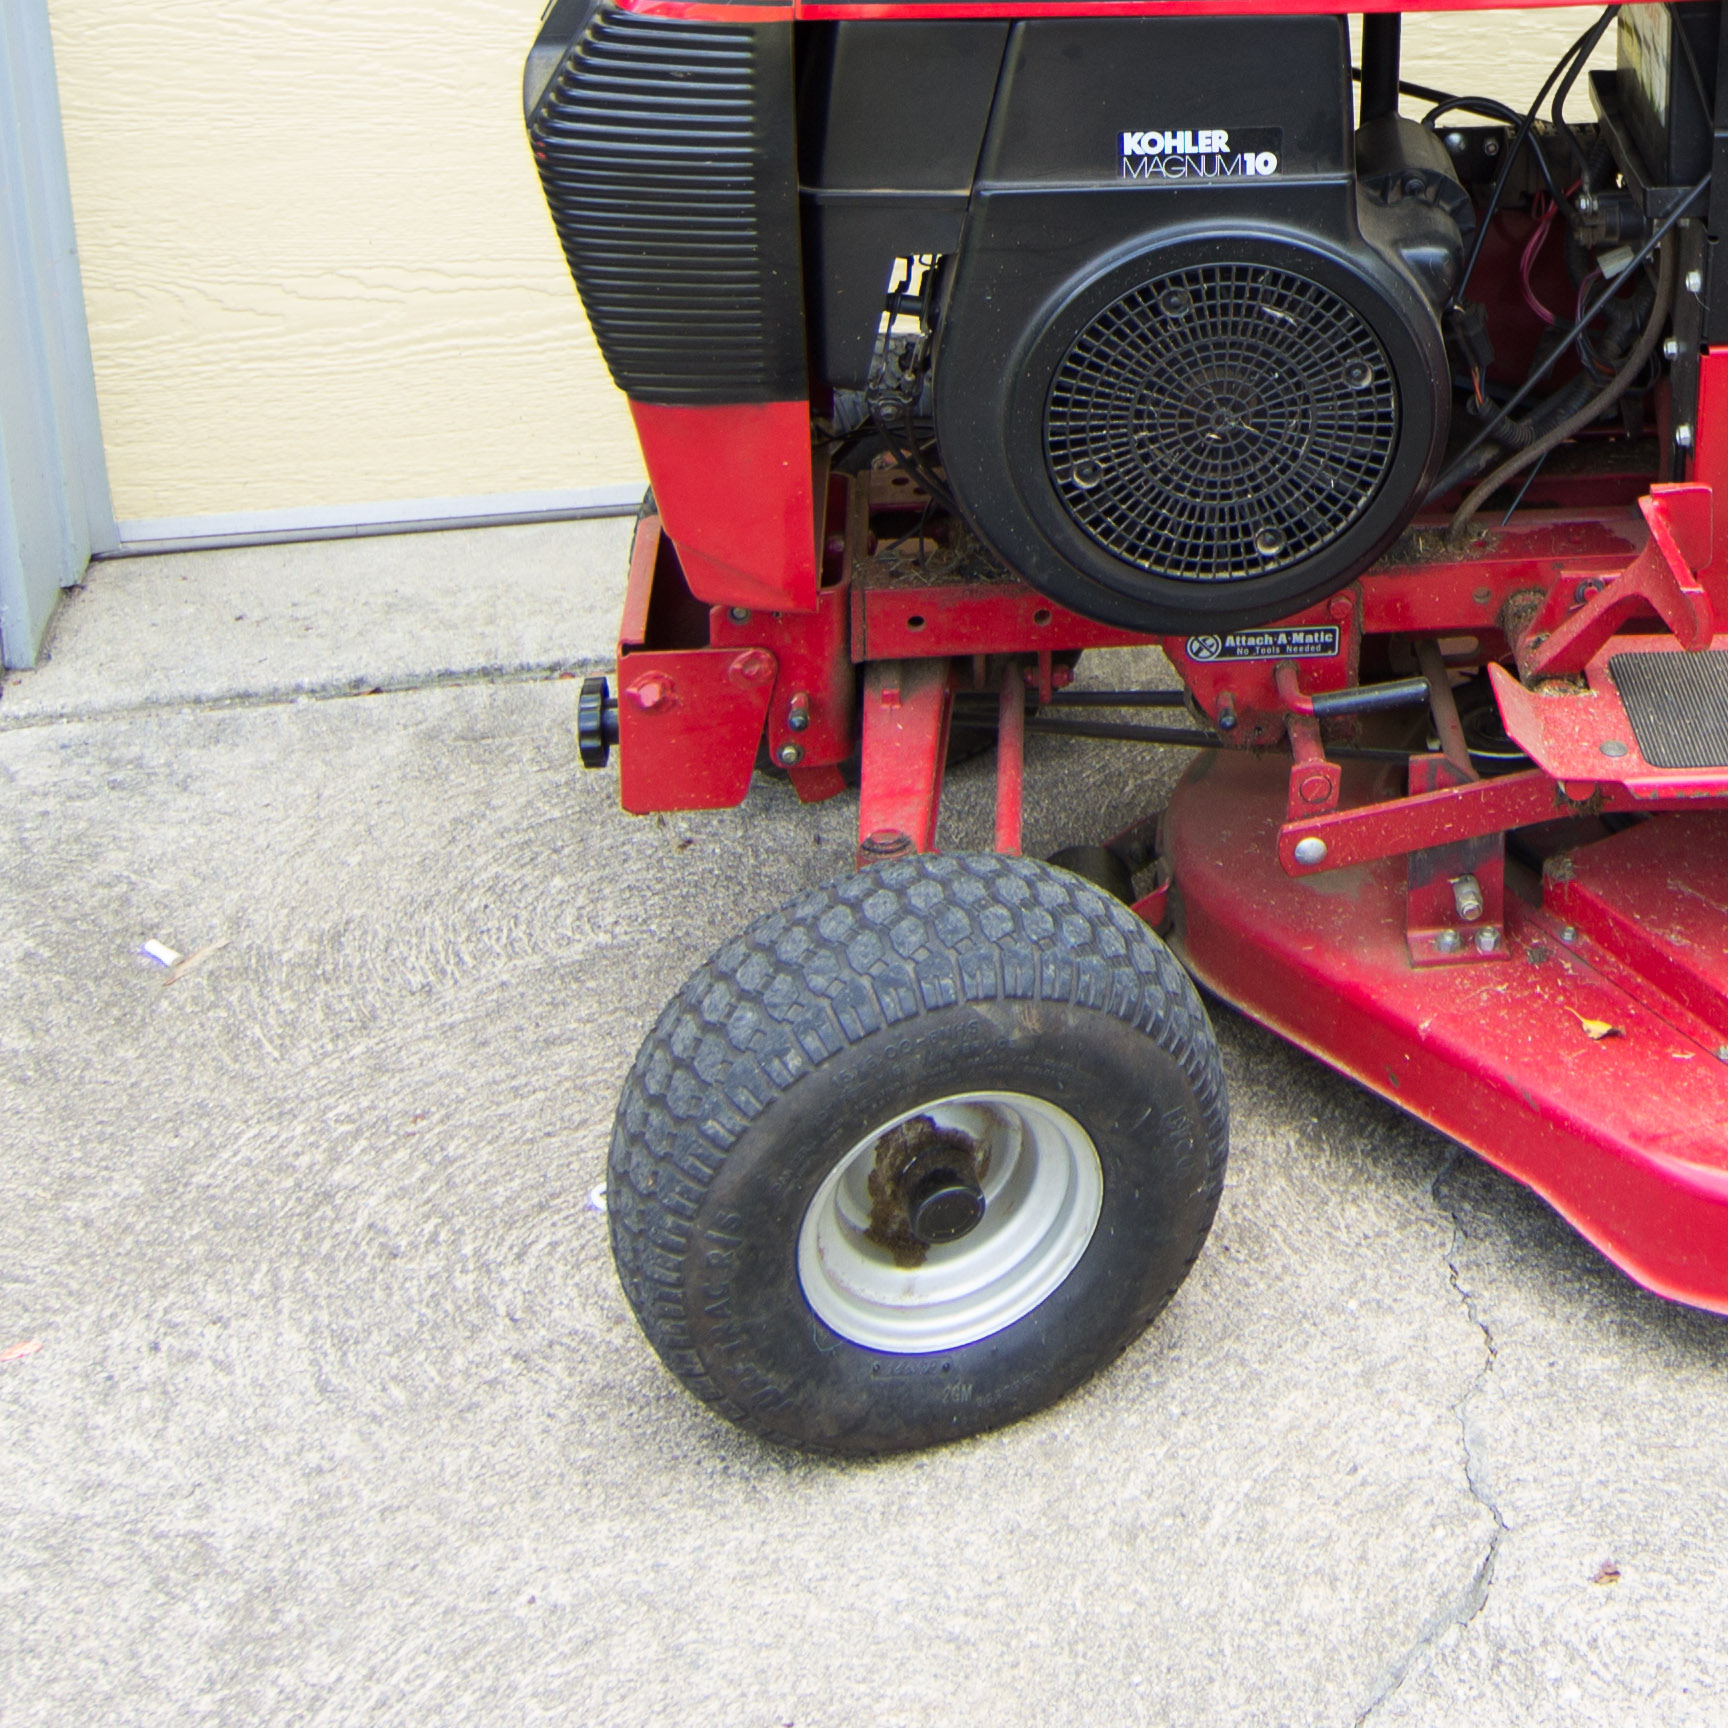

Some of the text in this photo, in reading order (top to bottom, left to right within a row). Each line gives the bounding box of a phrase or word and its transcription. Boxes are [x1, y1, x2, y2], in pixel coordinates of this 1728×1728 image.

[1123, 129, 1231, 156] KOHLER
[1236, 644, 1322, 656] No Tools Needed
